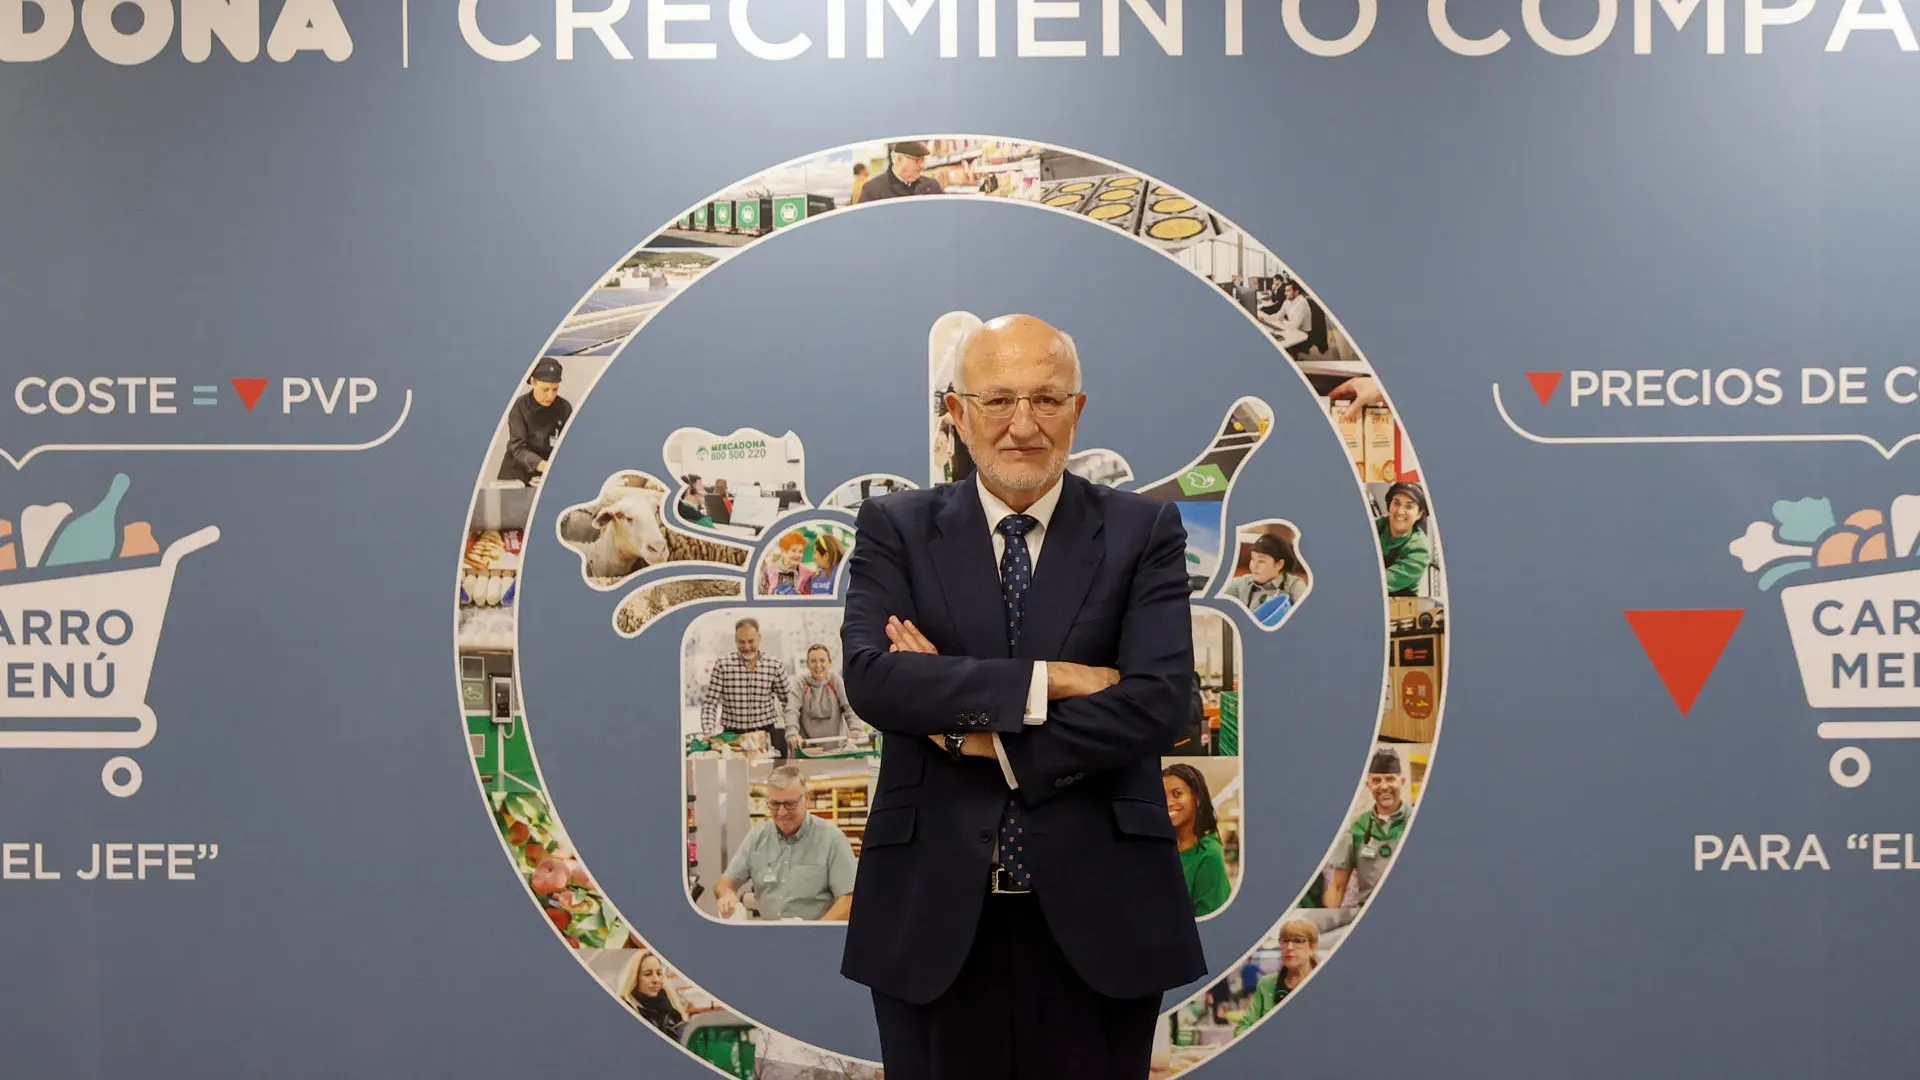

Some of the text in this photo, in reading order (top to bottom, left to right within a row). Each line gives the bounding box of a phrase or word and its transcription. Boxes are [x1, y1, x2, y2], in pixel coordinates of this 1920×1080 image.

[1427, 0, 1920, 57] COMPA
[14, 376, 177, 415] COSTE
[282, 377, 378, 414] PVP
[1570, 365, 1920, 407] PRECIOS DE C
[711, 440, 766, 451] MERCADONA
[728, 450, 745, 459] 500
[748, 449, 767, 459] 220
[1812, 599, 1920, 637] CAR
[7, 651, 115, 699] ENÚ
[1832, 652, 1920, 689] ME
[2, 843, 61, 880] EL
[1694, 833, 1831, 871] PARA
